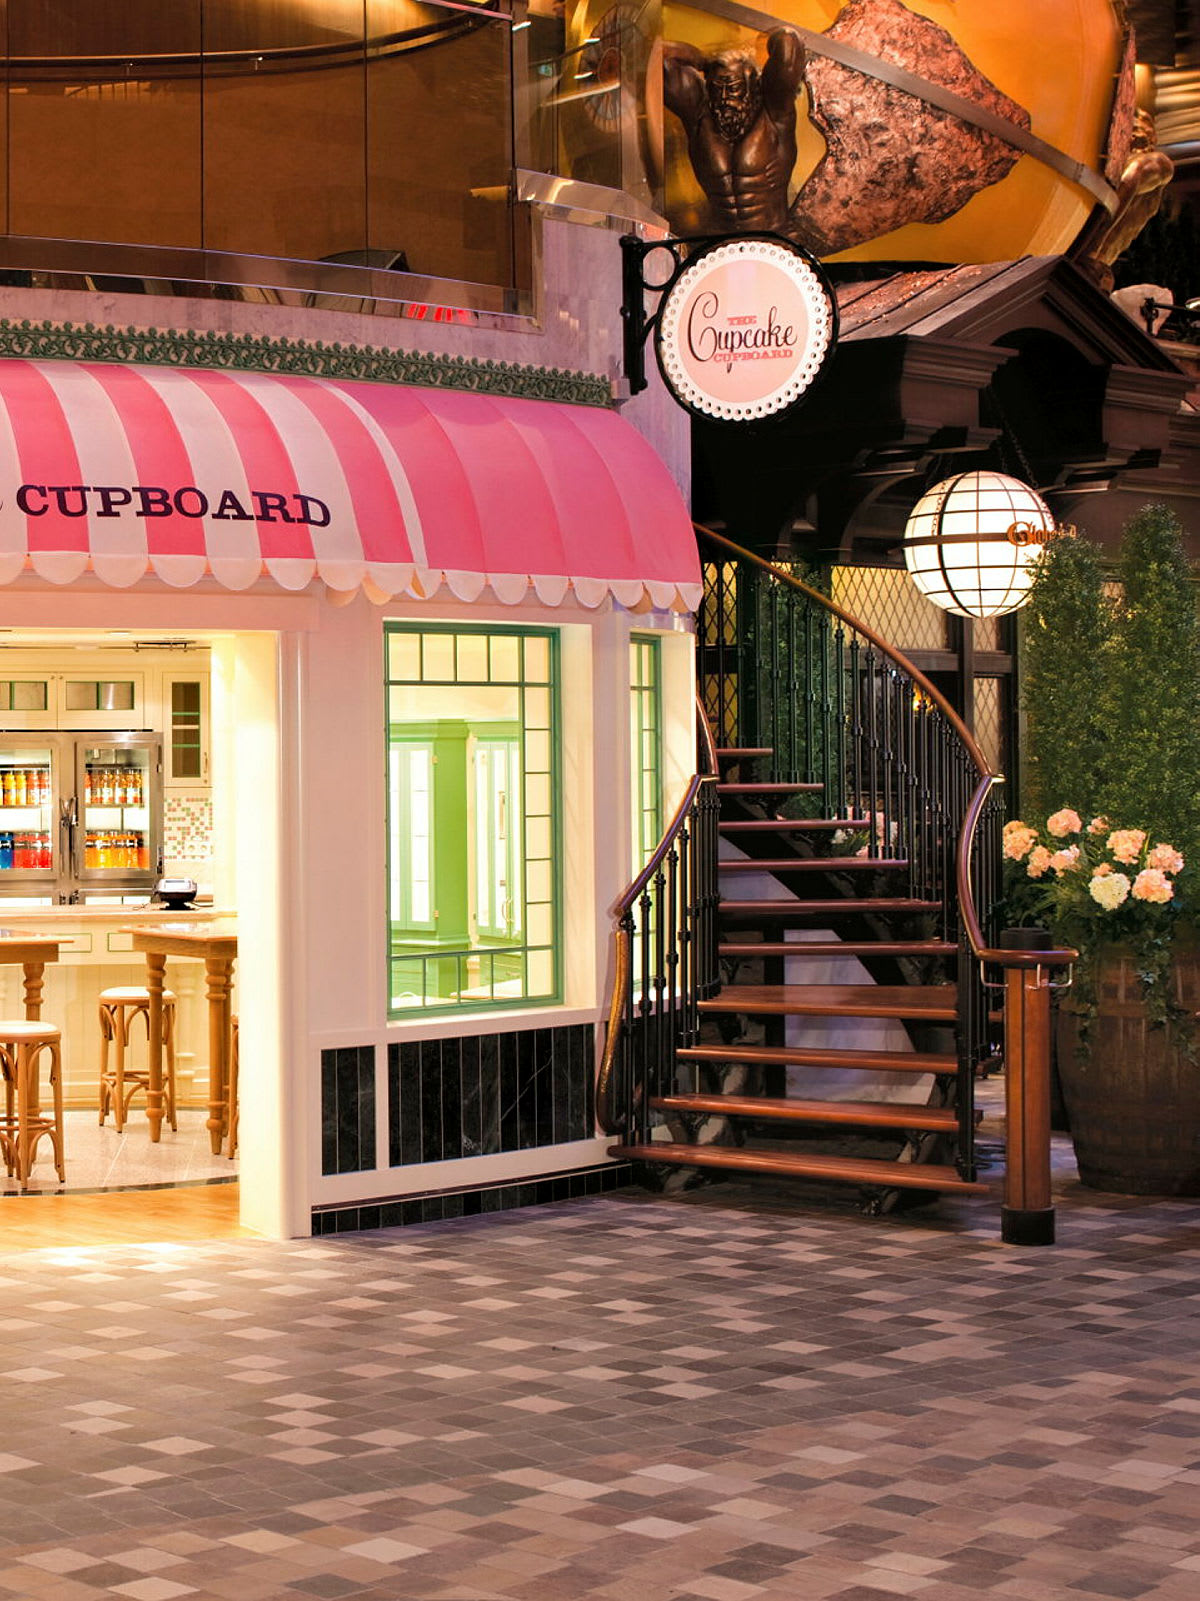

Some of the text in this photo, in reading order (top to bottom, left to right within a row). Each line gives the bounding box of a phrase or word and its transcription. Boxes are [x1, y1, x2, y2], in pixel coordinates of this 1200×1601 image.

[687, 291, 798, 373] Cupcake
[727, 315, 757, 326] THE
[714, 349, 793, 363] CUPBOARD
[16, 484, 331, 528] CUPBOARD
